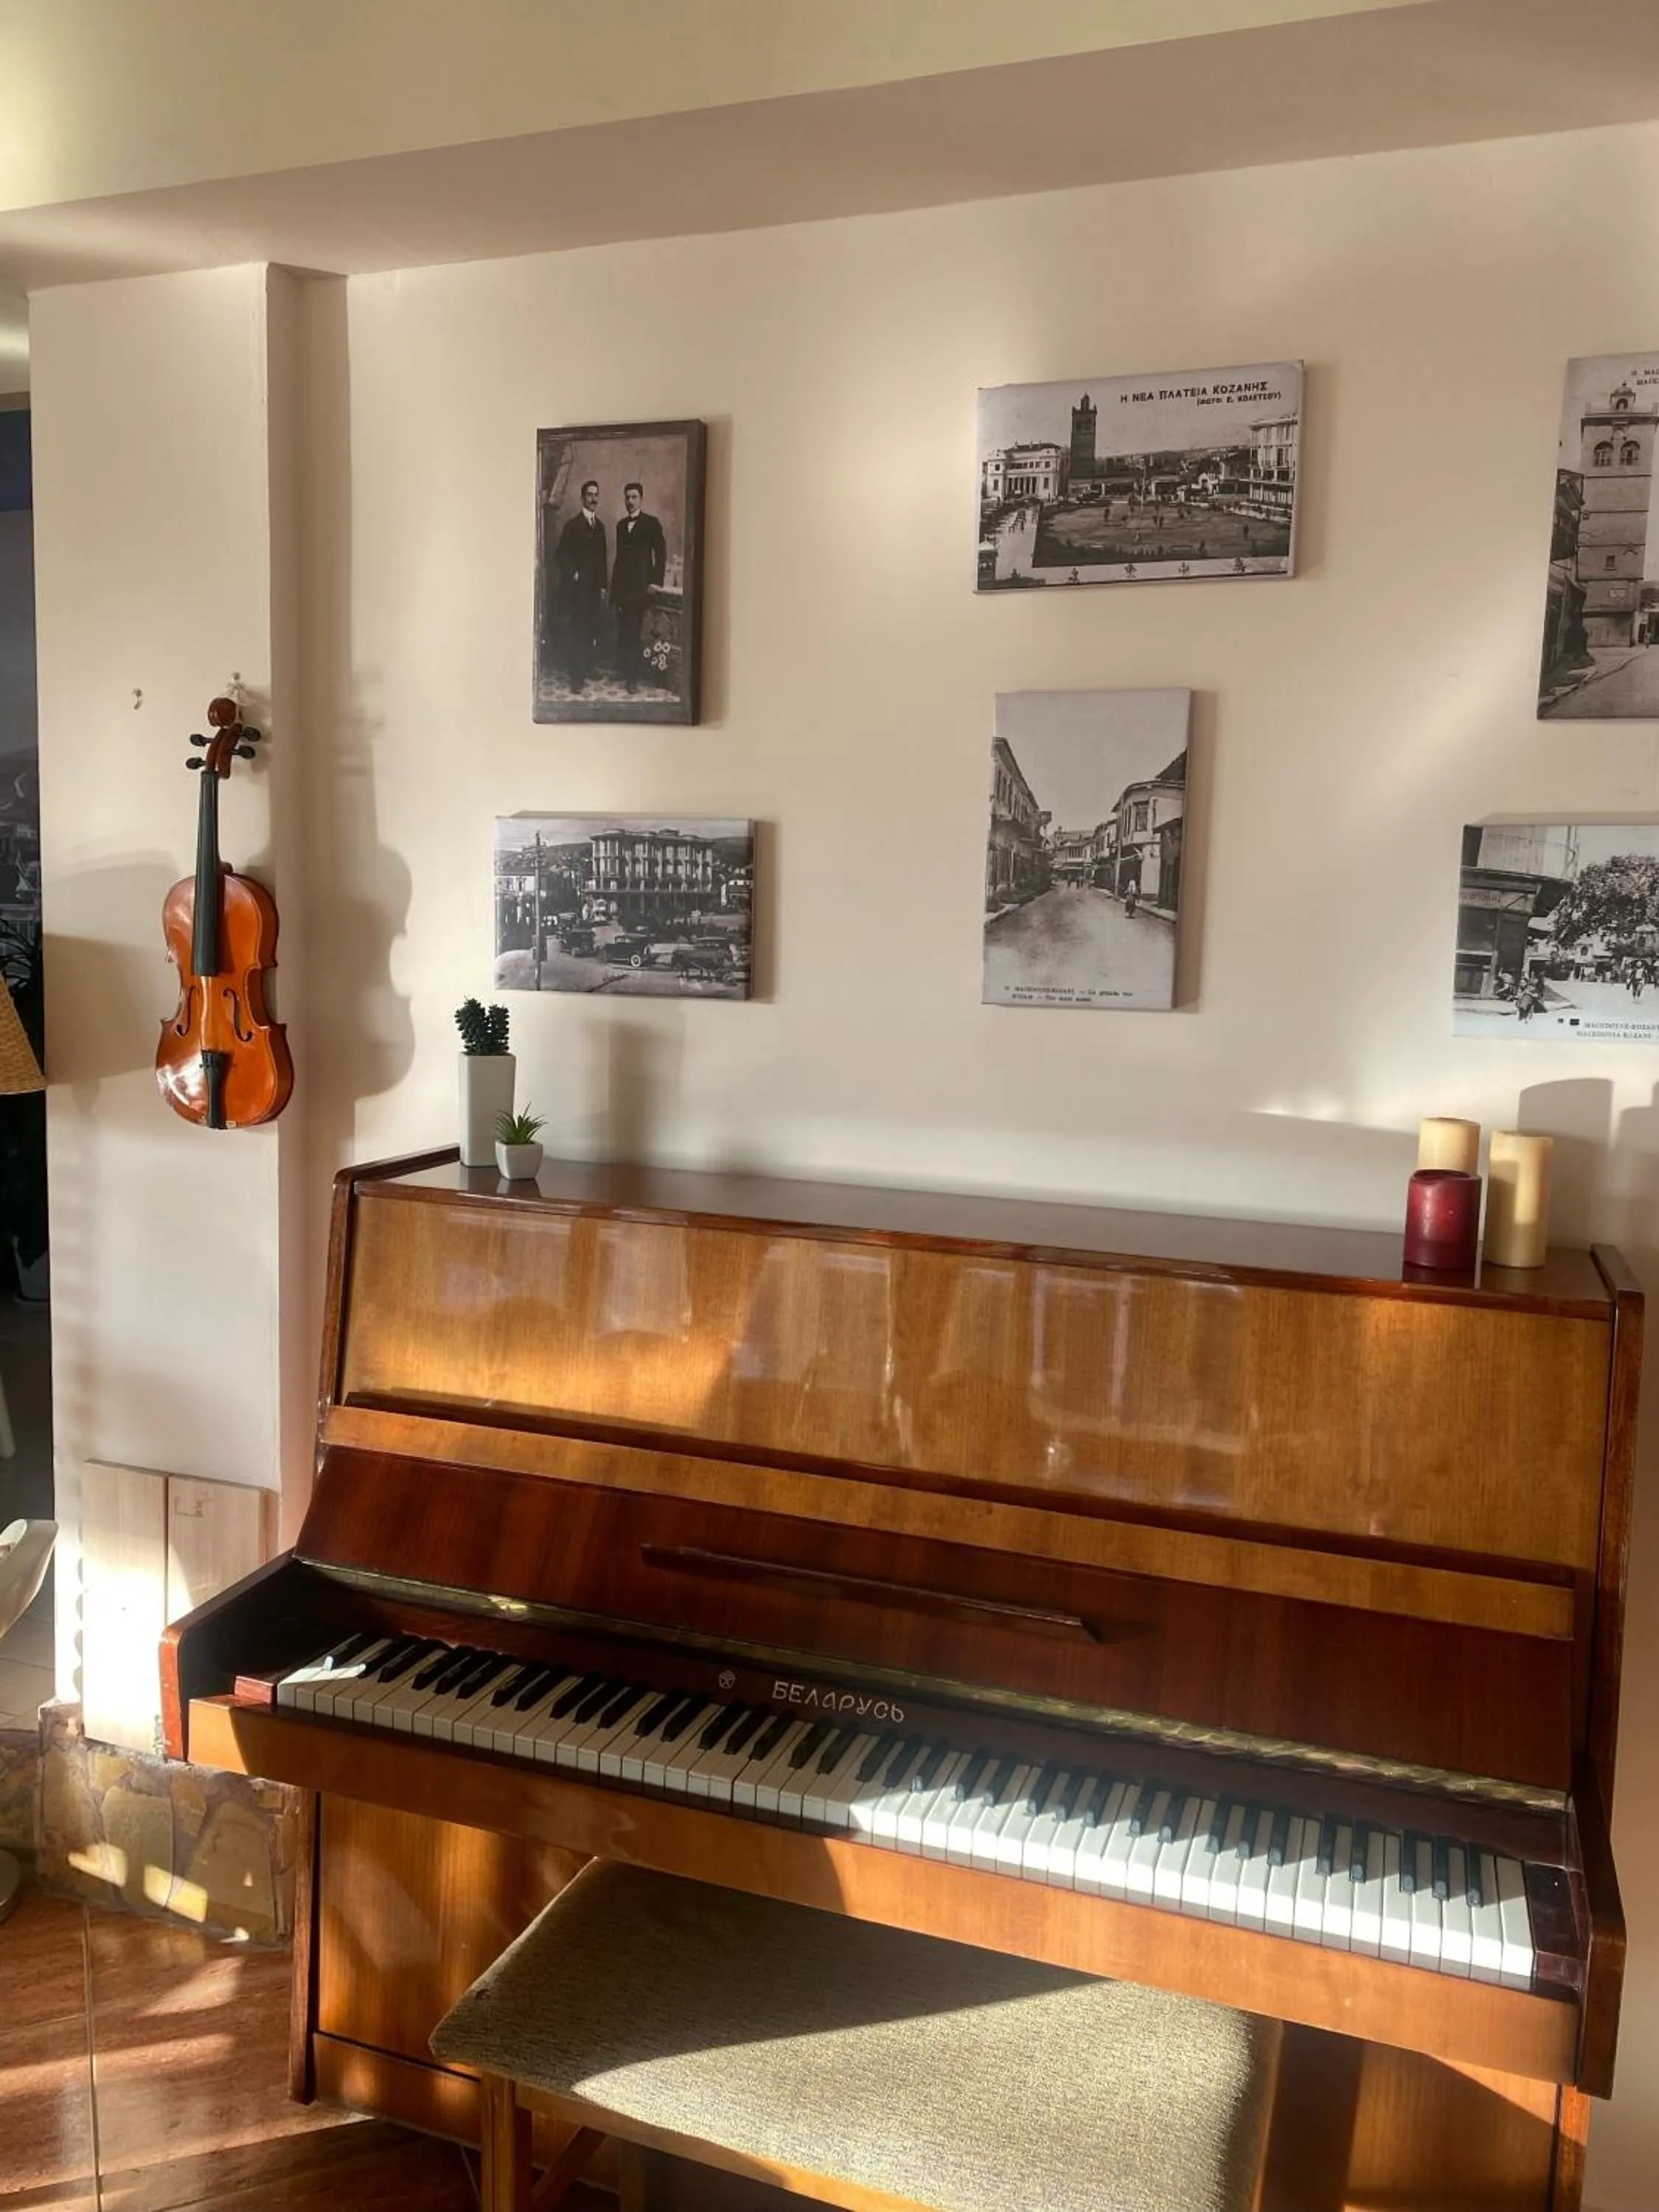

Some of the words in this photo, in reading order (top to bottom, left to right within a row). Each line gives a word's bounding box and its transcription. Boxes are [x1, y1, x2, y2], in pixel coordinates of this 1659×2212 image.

[1120, 394, 1127, 403] Η
[1132, 392, 1154, 402] ΝΕΑ
[1159, 387, 1207, 400] ΠΛΑΤΕΙΑ
[1213, 381, 1267, 394] ΚΟΖΑΝΗΣ
[772, 1680, 905, 1722] БЕЛАРУСЬ
